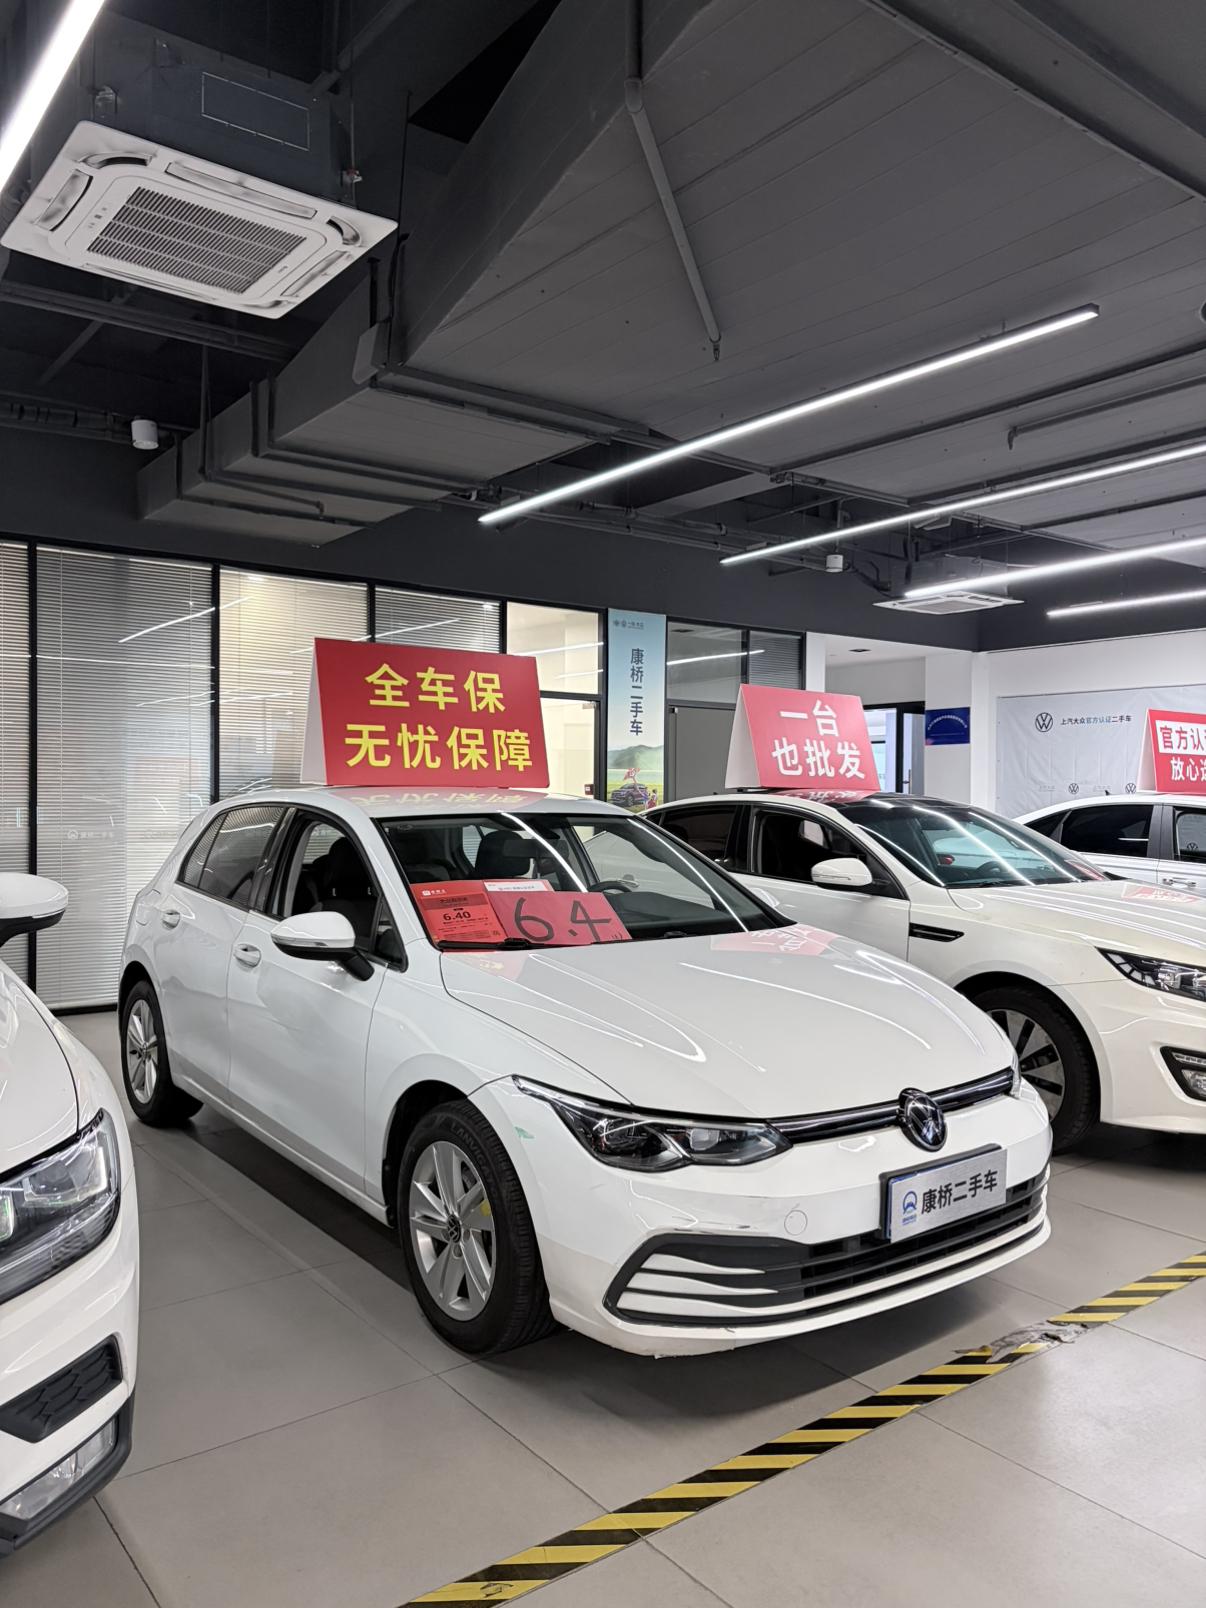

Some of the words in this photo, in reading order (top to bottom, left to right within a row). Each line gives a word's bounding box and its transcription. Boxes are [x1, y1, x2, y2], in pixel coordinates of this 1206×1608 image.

[364, 662, 506, 714] 全车保
[629, 647, 645, 736] 康桥二手车
[779, 699, 839, 737] 一台
[1060, 714, 1132, 726] 上汽大众官方认证二手车
[1159, 725, 1206, 751] 官方认
[344, 723, 533, 772] 无忧保障
[771, 736, 866, 780] 也批发
[443, 911, 471, 921] 6.40
[921, 1169, 998, 1215] 康桥二手车
